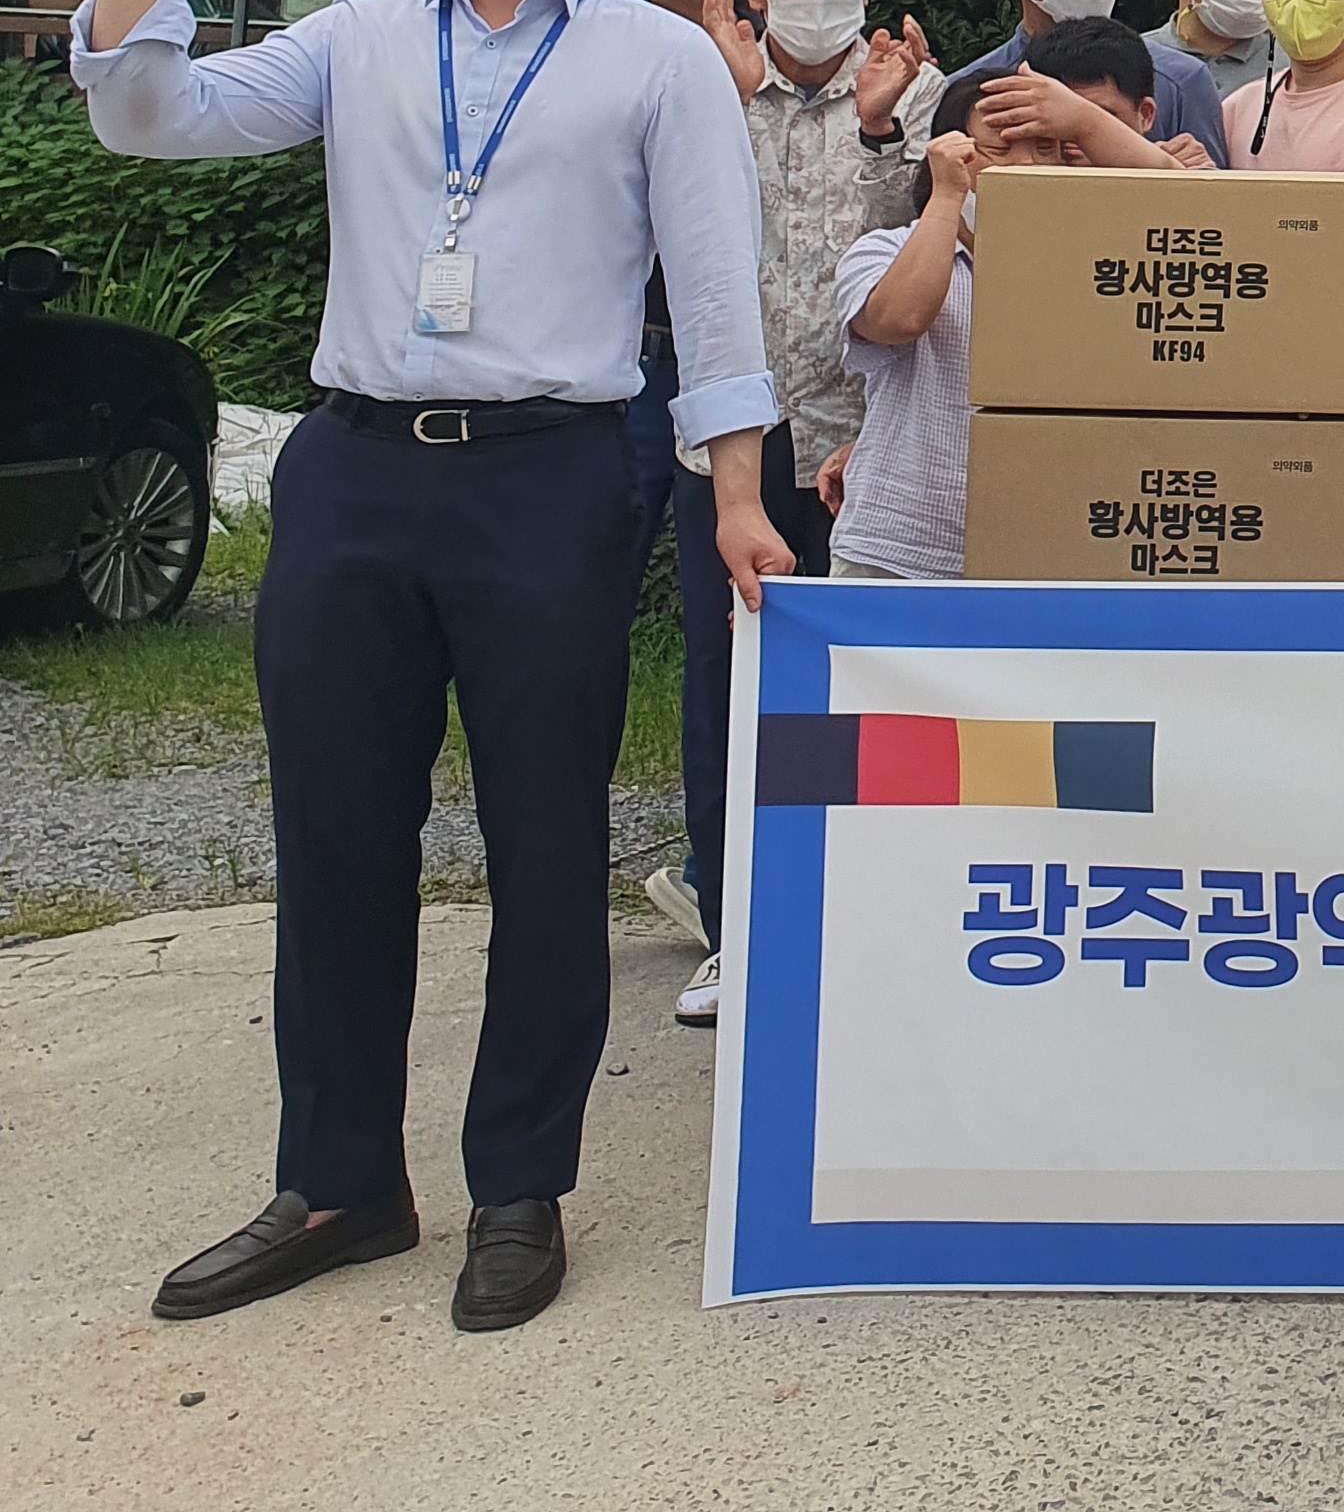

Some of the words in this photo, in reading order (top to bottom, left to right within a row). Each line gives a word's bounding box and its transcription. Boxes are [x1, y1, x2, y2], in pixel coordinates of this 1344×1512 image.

[1277, 219, 1320, 231] 의약외품
[1145, 228, 1223, 257] 더조은
[1093, 259, 1269, 299] 황사방역용
[1136, 301, 1225, 333] 마스크
[1152, 340, 1206, 362] KF94
[1272, 460, 1314, 473] 의약외품
[1140, 470, 1218, 498] 더조은
[1088, 501, 1264, 541] 황사방역용
[1131, 543, 1220, 576] 마스크
